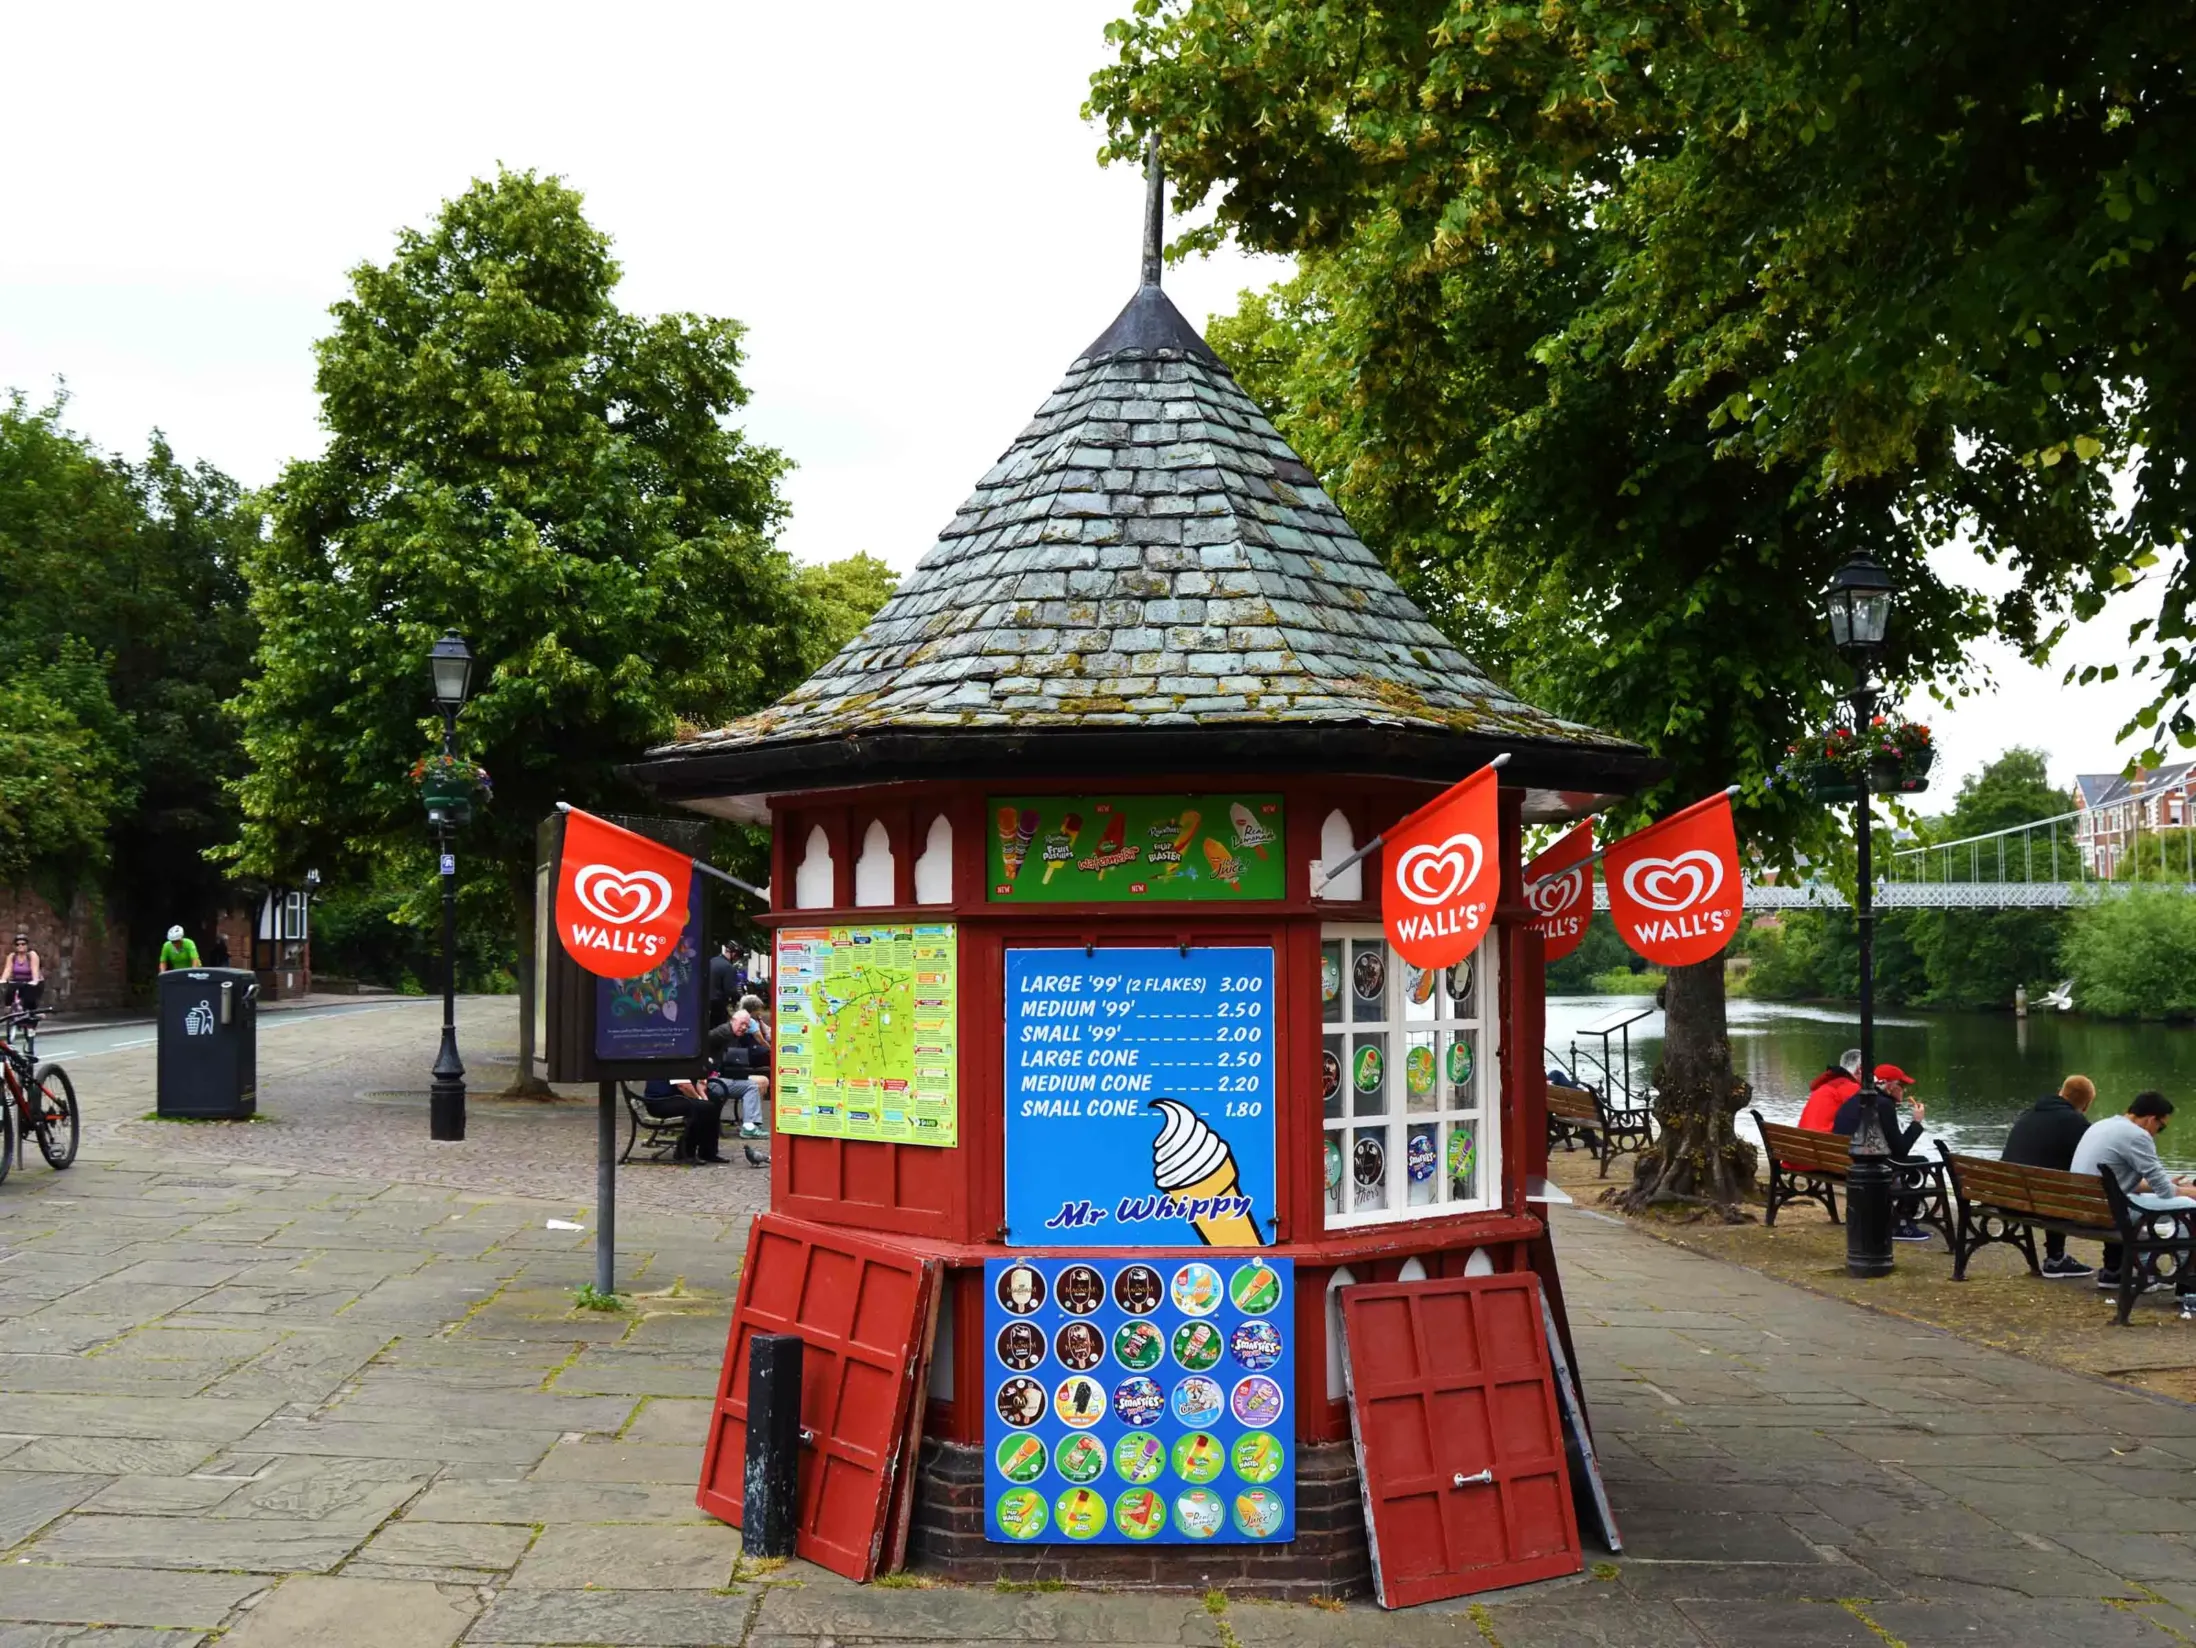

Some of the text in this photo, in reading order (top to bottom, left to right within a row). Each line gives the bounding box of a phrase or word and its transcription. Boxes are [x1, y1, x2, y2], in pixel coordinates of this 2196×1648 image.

[1244, 824, 1265, 835] Real
[1231, 831, 1276, 848] Lemonade
[1047, 845, 1070, 854] Fruit
[1153, 843, 1172, 851] FRUIT
[1042, 850, 1075, 861] Pastilles
[1077, 845, 1140, 872] Watermelon
[1148, 851, 1182, 862] BLASTER
[996, 885, 1012, 894] NEW
[1131, 884, 1146, 893] NEW
[1020, 975, 1263, 994] LARGE '99' (2 FLAKES) 3.00
[1021, 1000, 1261, 1018] MEDIUM '99' 2.50
[1020, 1025, 1262, 1043] SMALL '99' 2.00
[1020, 1049, 1262, 1068] LARGE CONE 2.50
[1021, 1074, 1259, 1092] MEDIUM CONE 2.20
[1020, 1099, 1262, 1117] SMALL CONE 1.80
[1046, 1194, 1253, 1228] Mr Whippy
[1065, 1286, 1096, 1294] MAGNUM
[1123, 1285, 1154, 1294] MAGNUM
[1006, 1341, 1037, 1351] MAGNUM
[1234, 1339, 1277, 1353] SMARTIES
[1118, 1396, 1160, 1410] SMARTIES
